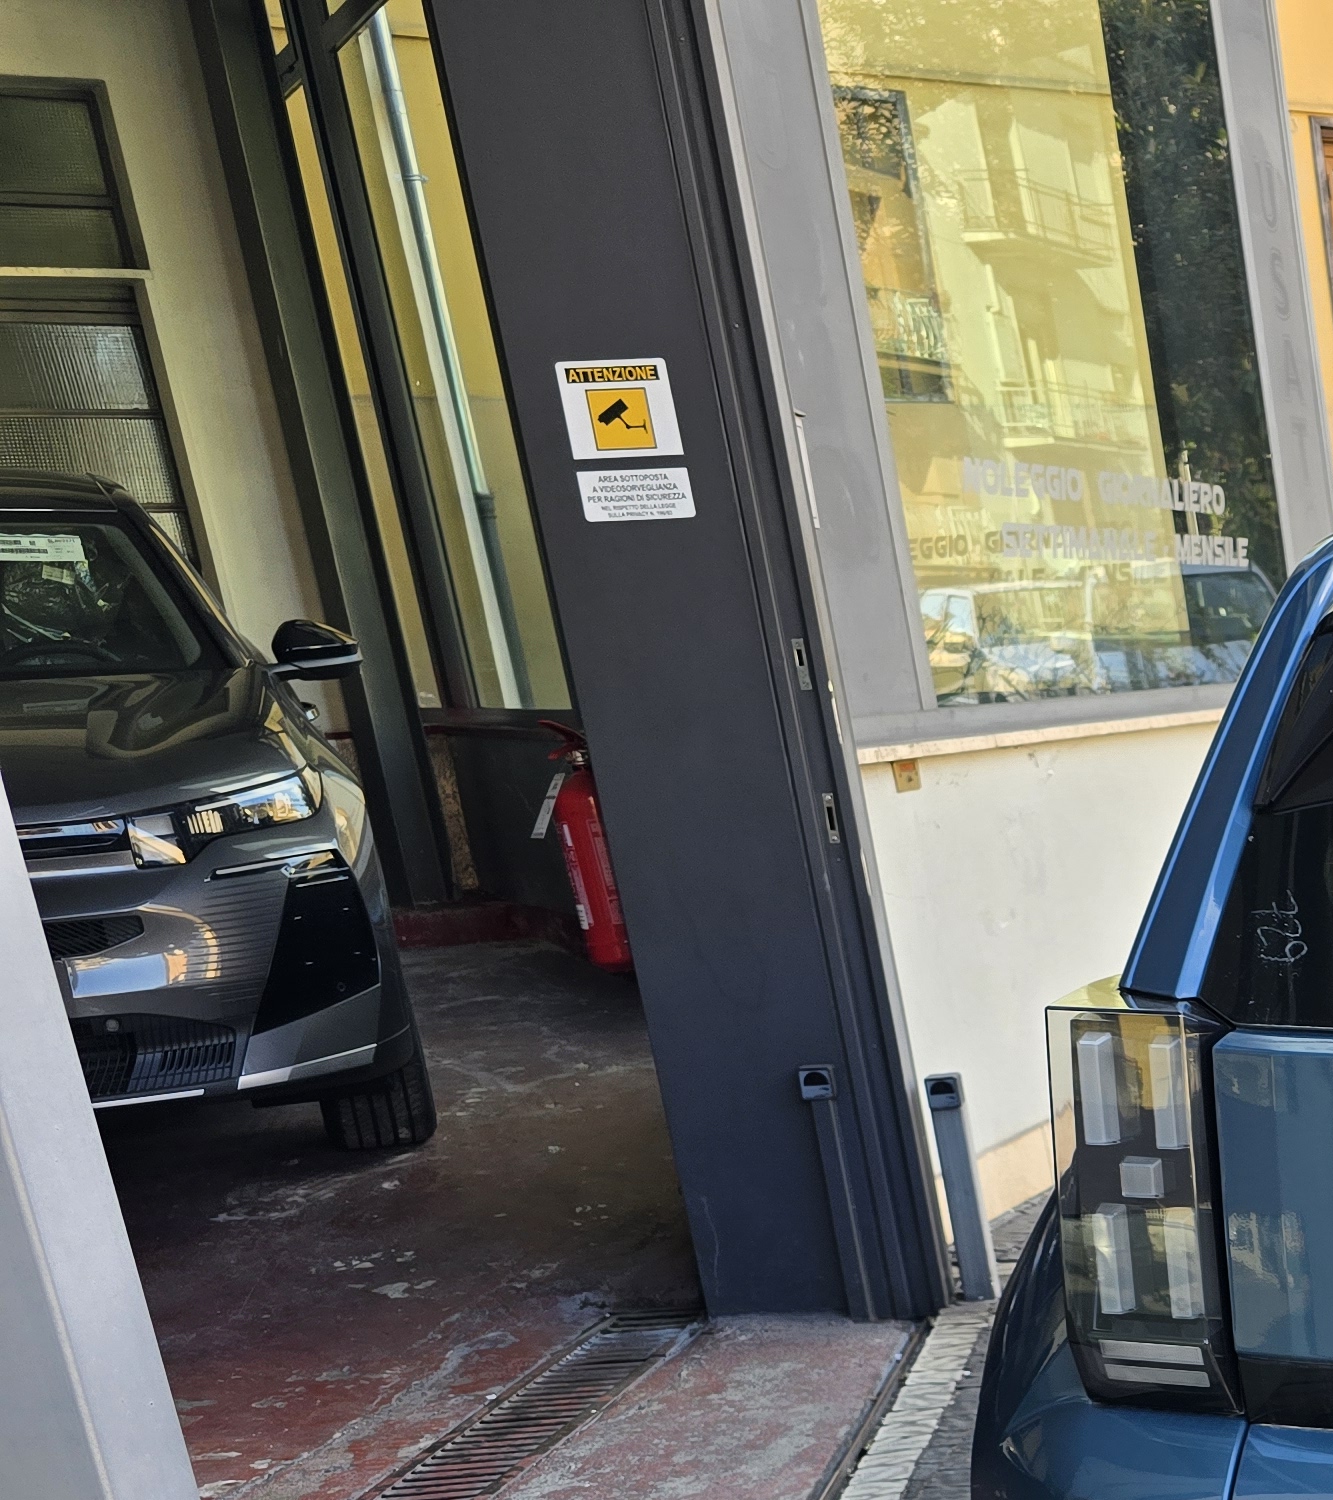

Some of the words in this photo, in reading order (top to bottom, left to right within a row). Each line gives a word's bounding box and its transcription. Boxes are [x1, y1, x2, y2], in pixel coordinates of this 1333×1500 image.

[568, 366, 657, 382] ATTENZIONE
[620, 474, 669, 482] SOTTOPOSTA
[600, 483, 678, 493] VIDEOSORVEGLIANZA
[963, 456, 1083, 502] NOLEGGIO
[1098, 470, 1226, 515] GIORNALIERO
[646, 493, 687, 501] SICUREZZA
[1002, 522, 1157, 562] SETTIMANALE
[1174, 534, 1249, 567] MENSILE
